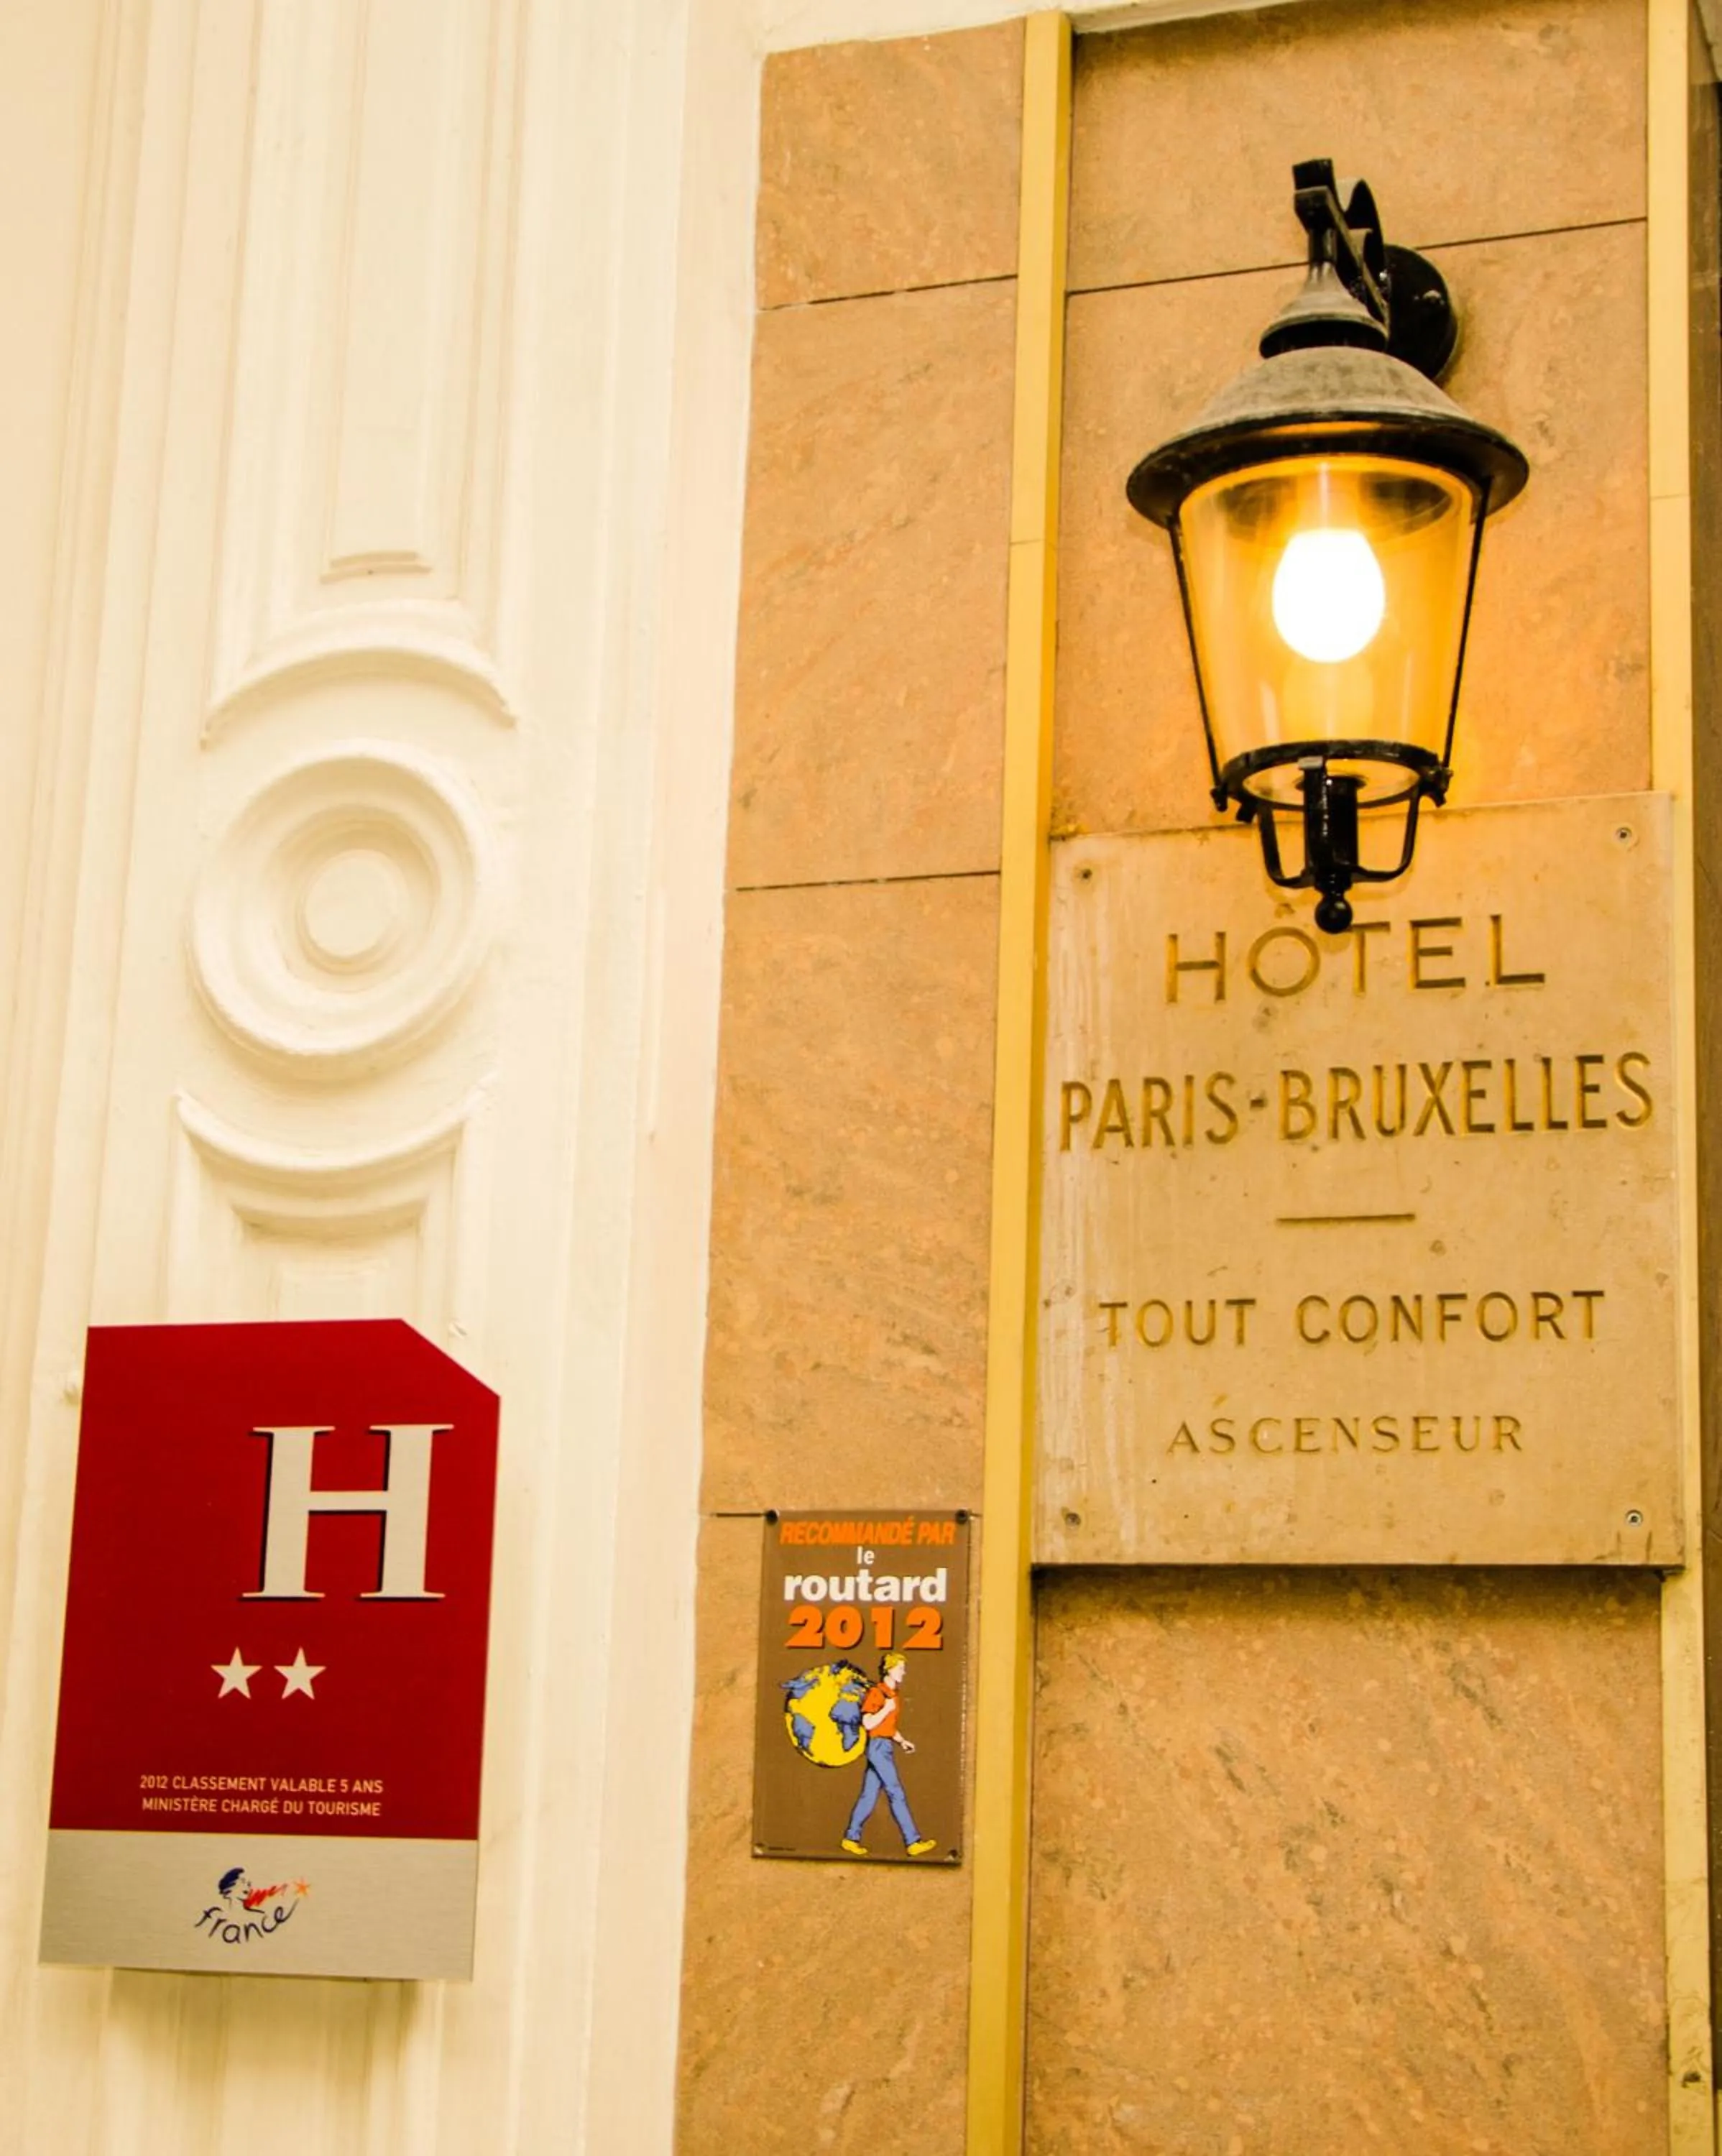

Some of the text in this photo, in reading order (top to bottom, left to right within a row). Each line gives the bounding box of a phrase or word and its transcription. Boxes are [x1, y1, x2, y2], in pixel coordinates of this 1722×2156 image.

[1099, 1289, 1605, 1348] TOUT CONFORT
[1167, 1414, 1524, 1455] ASCENSEUR
[238, 1423, 455, 1603] H
[780, 1516, 957, 1545] RECOMMANDÉ PAR
[857, 1546, 875, 1565] le
[783, 1567, 948, 1603] routard
[784, 1605, 944, 1651] 2012
[140, 1774, 384, 1795] 2012 CLASSEMENT VALABLE 5 ANS
[142, 1795, 382, 1817] MINISTÈRE CHARGÉ DU TOURISME
[194, 1898, 300, 1944] france
